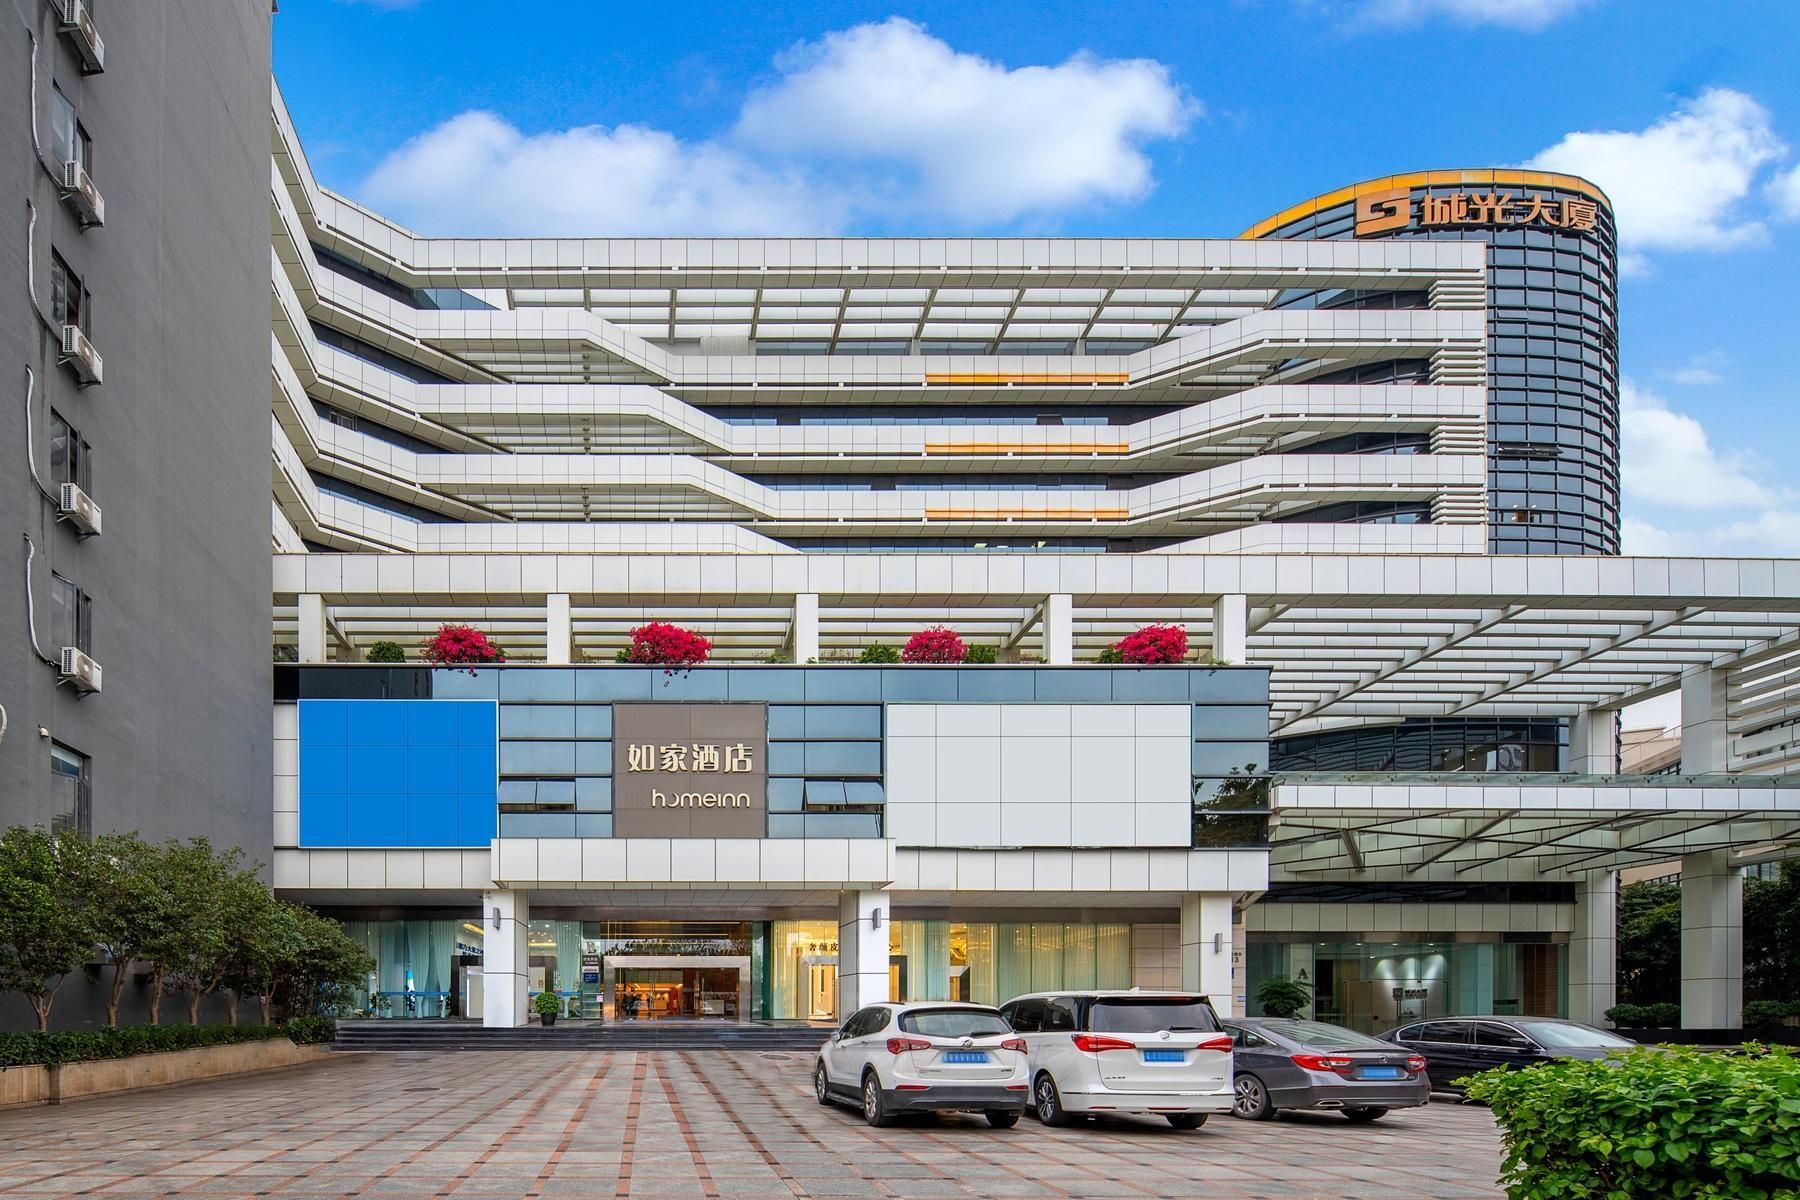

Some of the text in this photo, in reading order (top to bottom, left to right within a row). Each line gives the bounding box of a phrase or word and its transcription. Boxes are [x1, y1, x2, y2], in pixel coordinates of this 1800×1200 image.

[1421, 192, 1597, 233] 城光大厦
[628, 743, 753, 773] 如家酒店
[651, 788, 750, 808] homeinn
[1297, 967, 1309, 980] A
